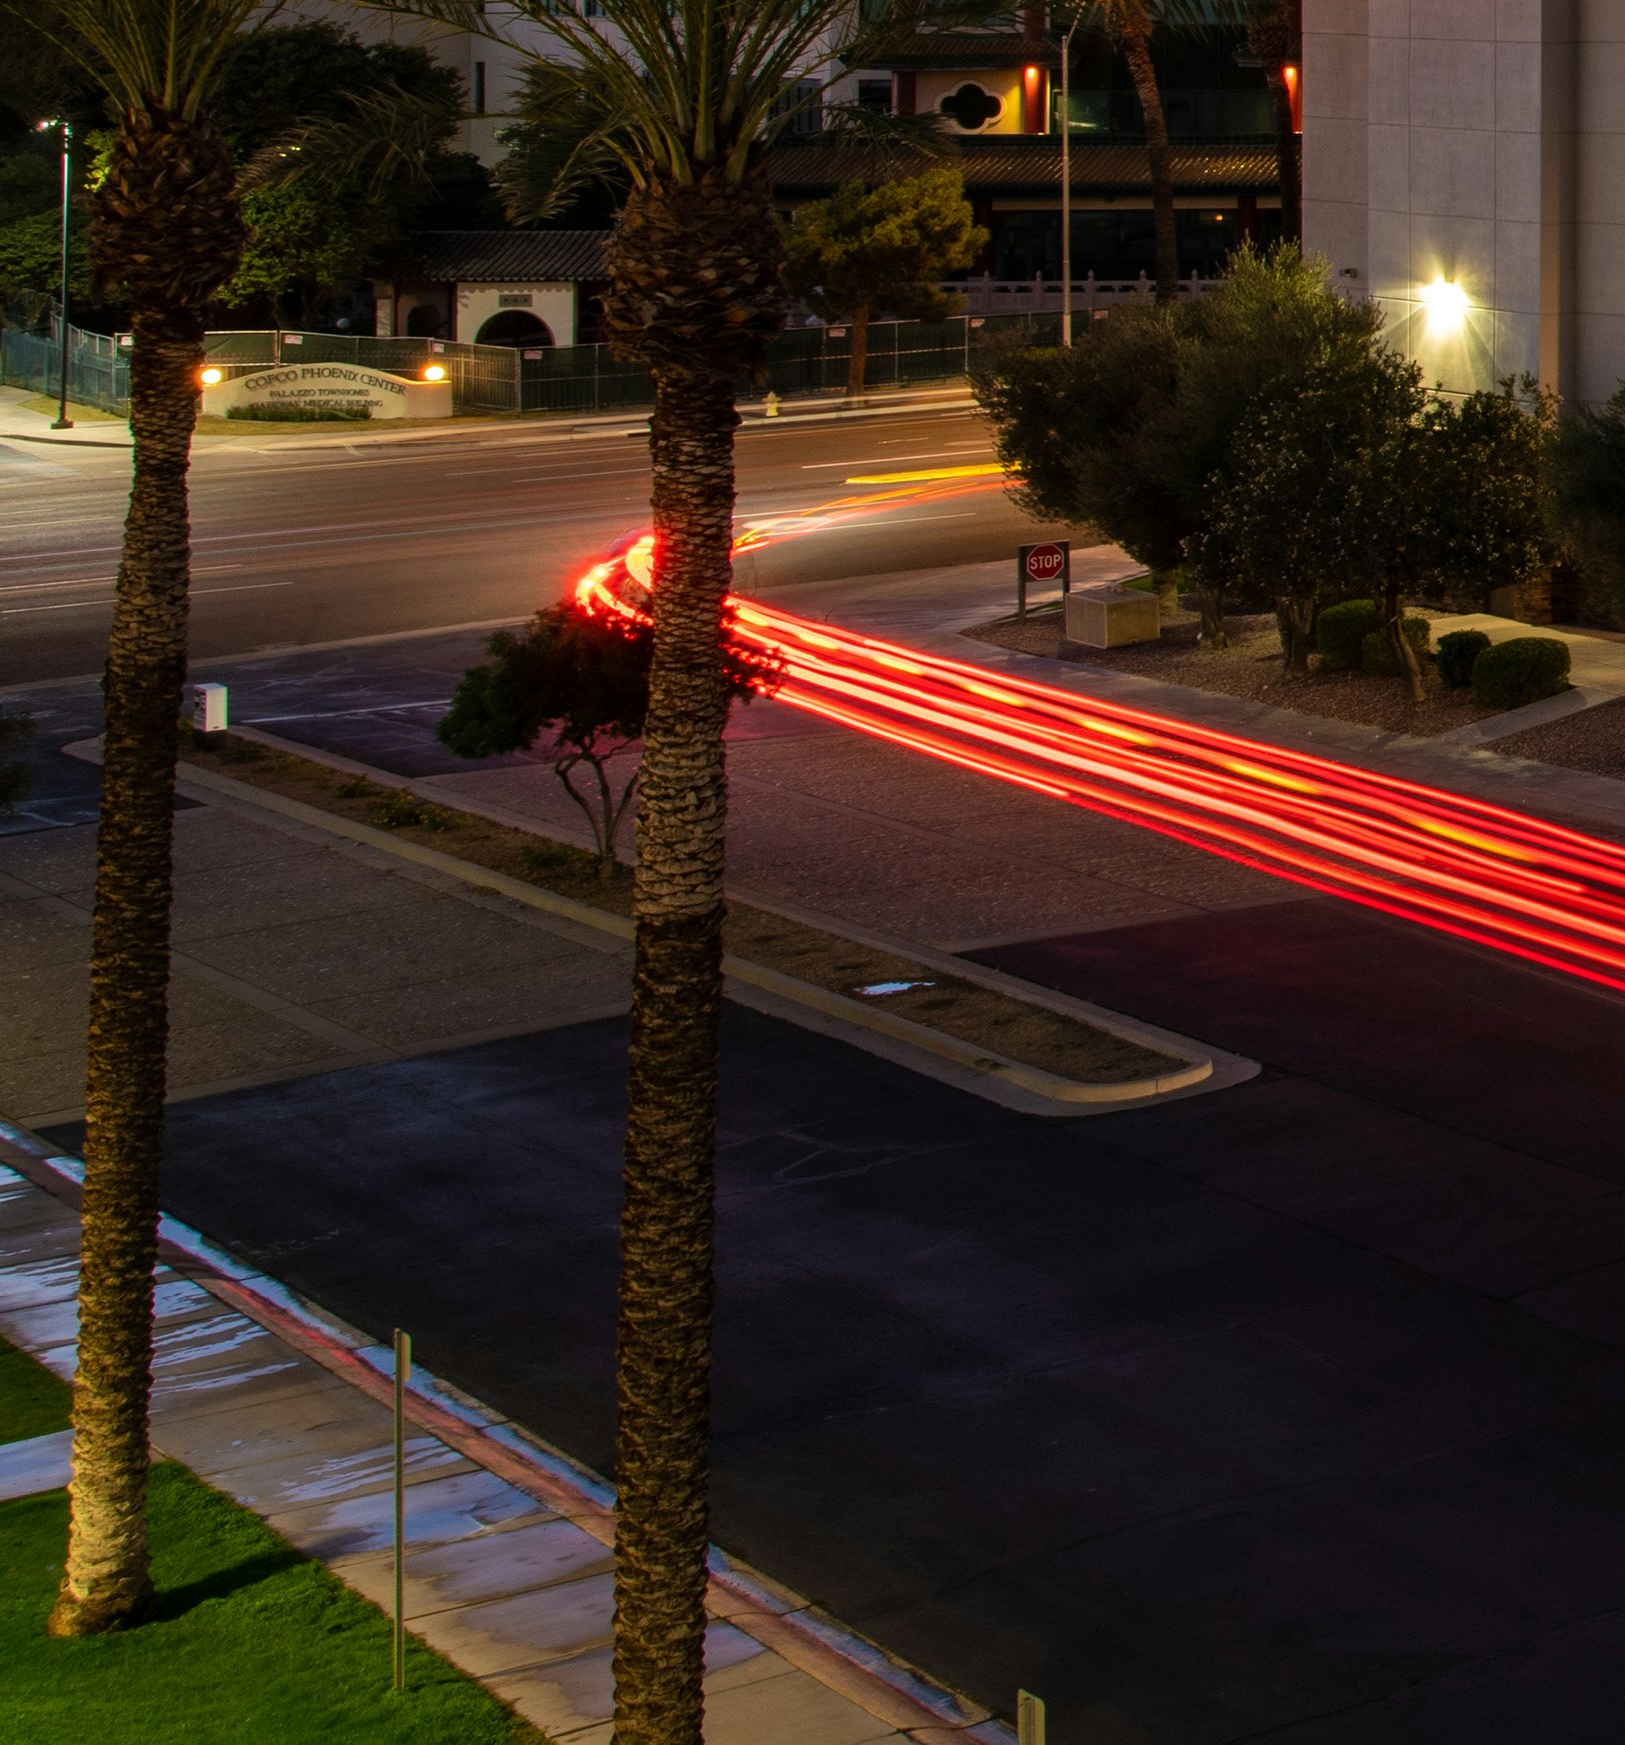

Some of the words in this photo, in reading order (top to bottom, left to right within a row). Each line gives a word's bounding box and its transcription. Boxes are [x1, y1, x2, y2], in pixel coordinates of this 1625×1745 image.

[245, 370, 298, 389] COFCO
[302, 367, 358, 382] PHOENIX
[361, 374, 406, 395] CENTER
[269, 389, 316, 397] PALAZZO
[318, 388, 370, 397] TOWNHOMES
[303, 399, 346, 407] MEDICAL
[346, 399, 384, 407] BUILDING
[1030, 554, 1062, 570] STOP
